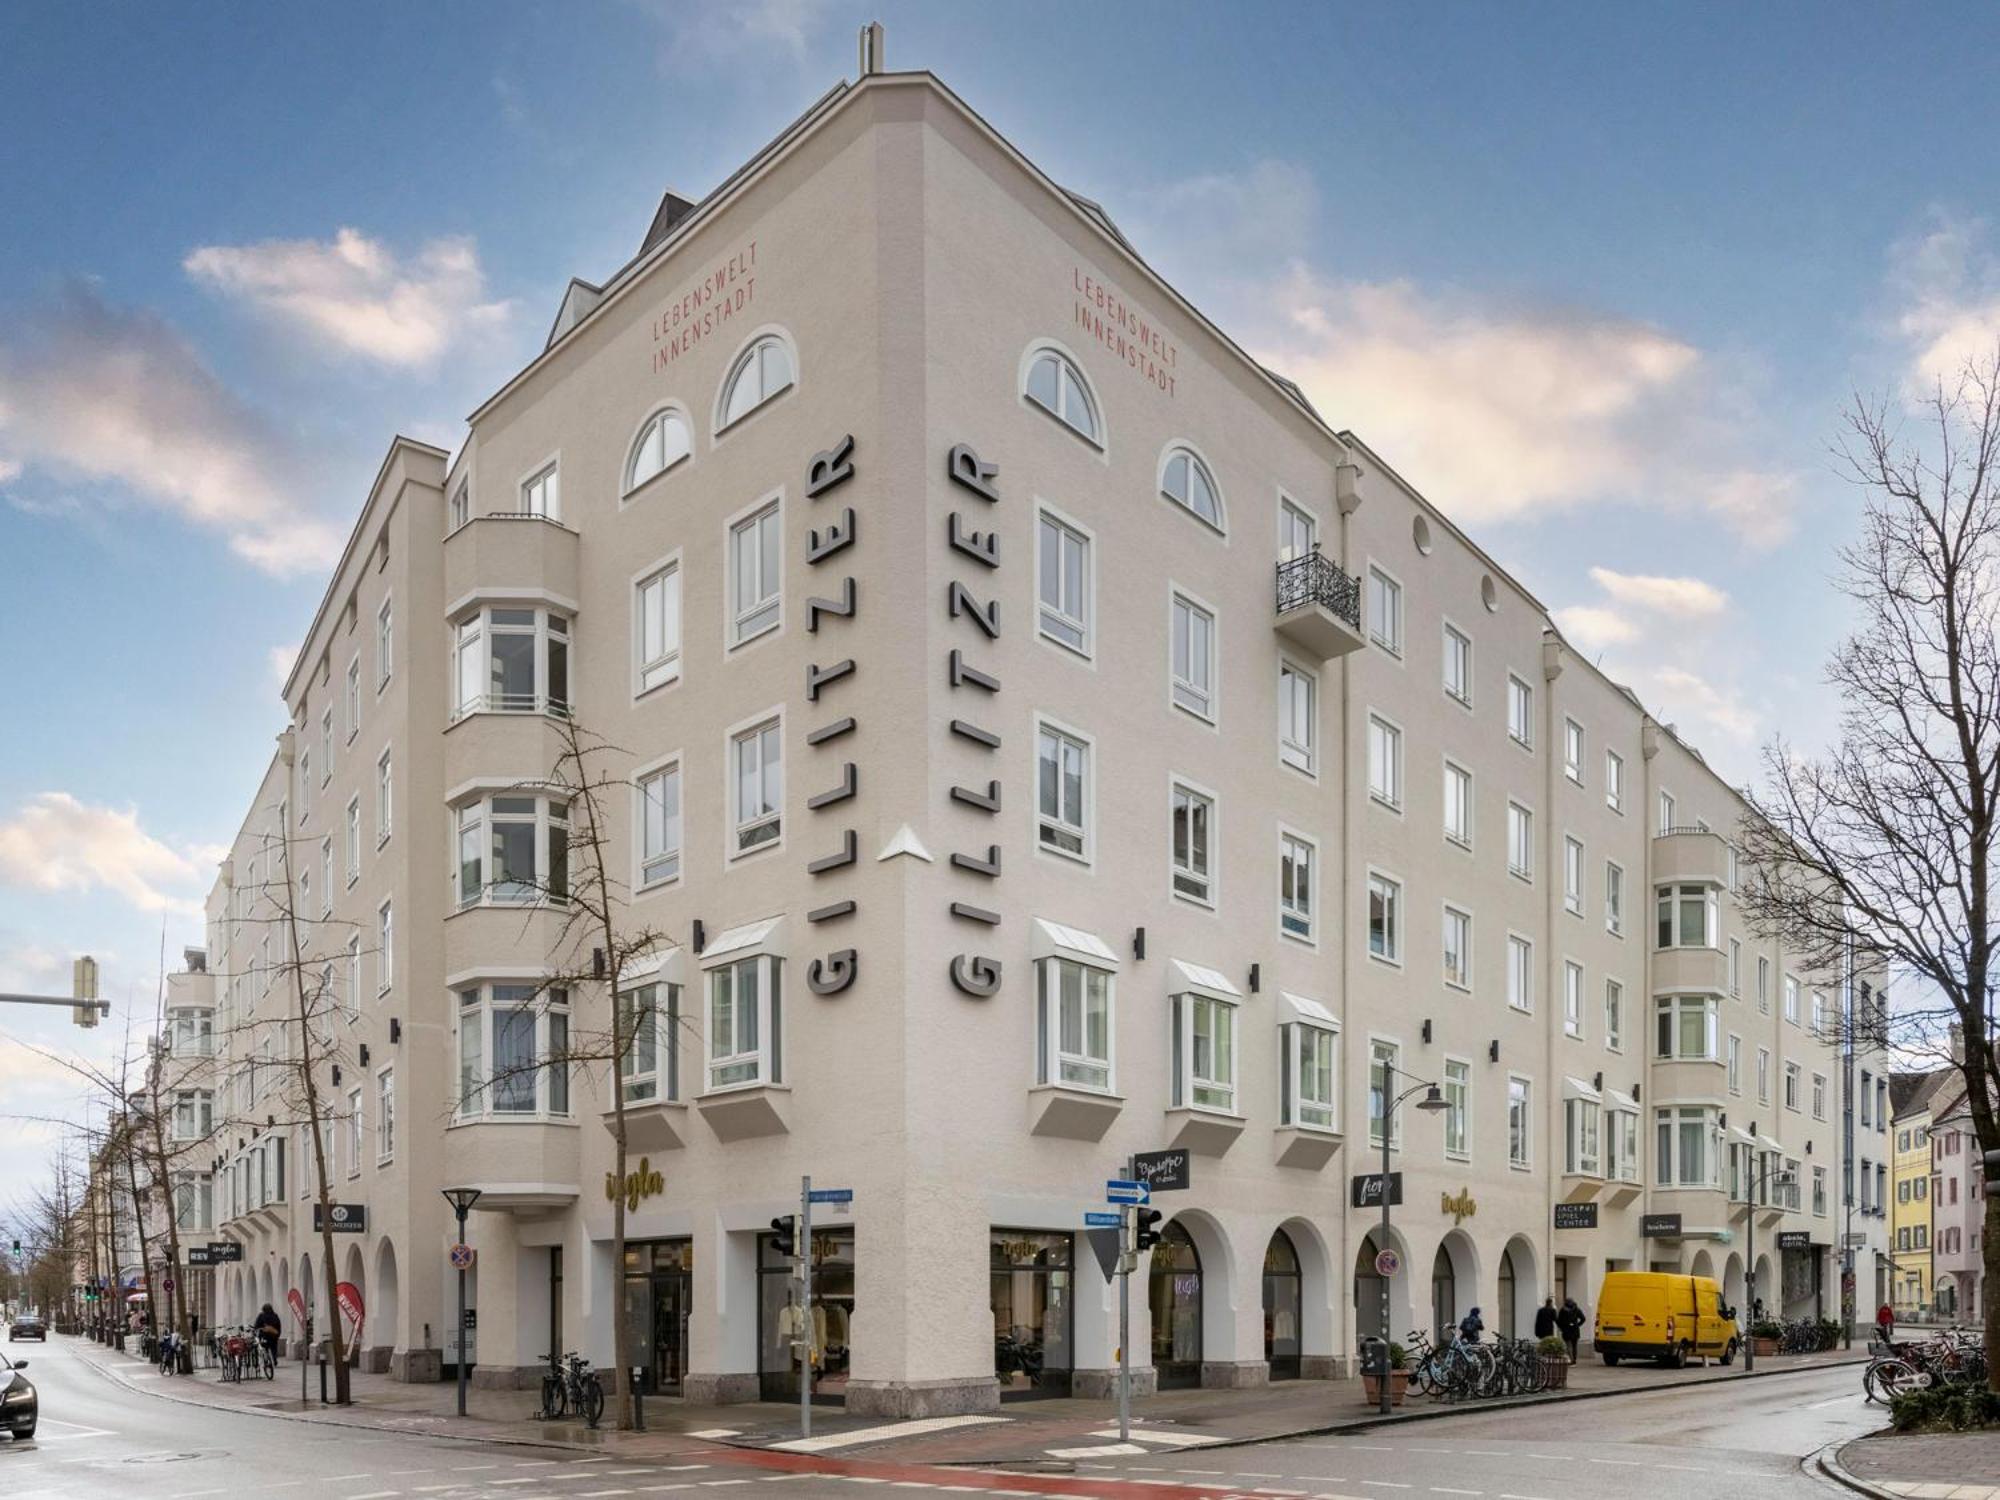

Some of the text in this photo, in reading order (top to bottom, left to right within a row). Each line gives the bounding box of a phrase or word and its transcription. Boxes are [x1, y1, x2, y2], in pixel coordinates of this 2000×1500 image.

[653, 241, 756, 342] LEBENSWELT
[653, 277, 755, 374] INNENSTADT
[1074, 266, 1177, 368] LEBENSWELT
[1074, 301, 1175, 398] INNENSTADT
[807, 433, 857, 996] GILLITZER
[949, 442, 1002, 998] GILLITZER
[1556, 1219, 1590, 1228] CENTER
